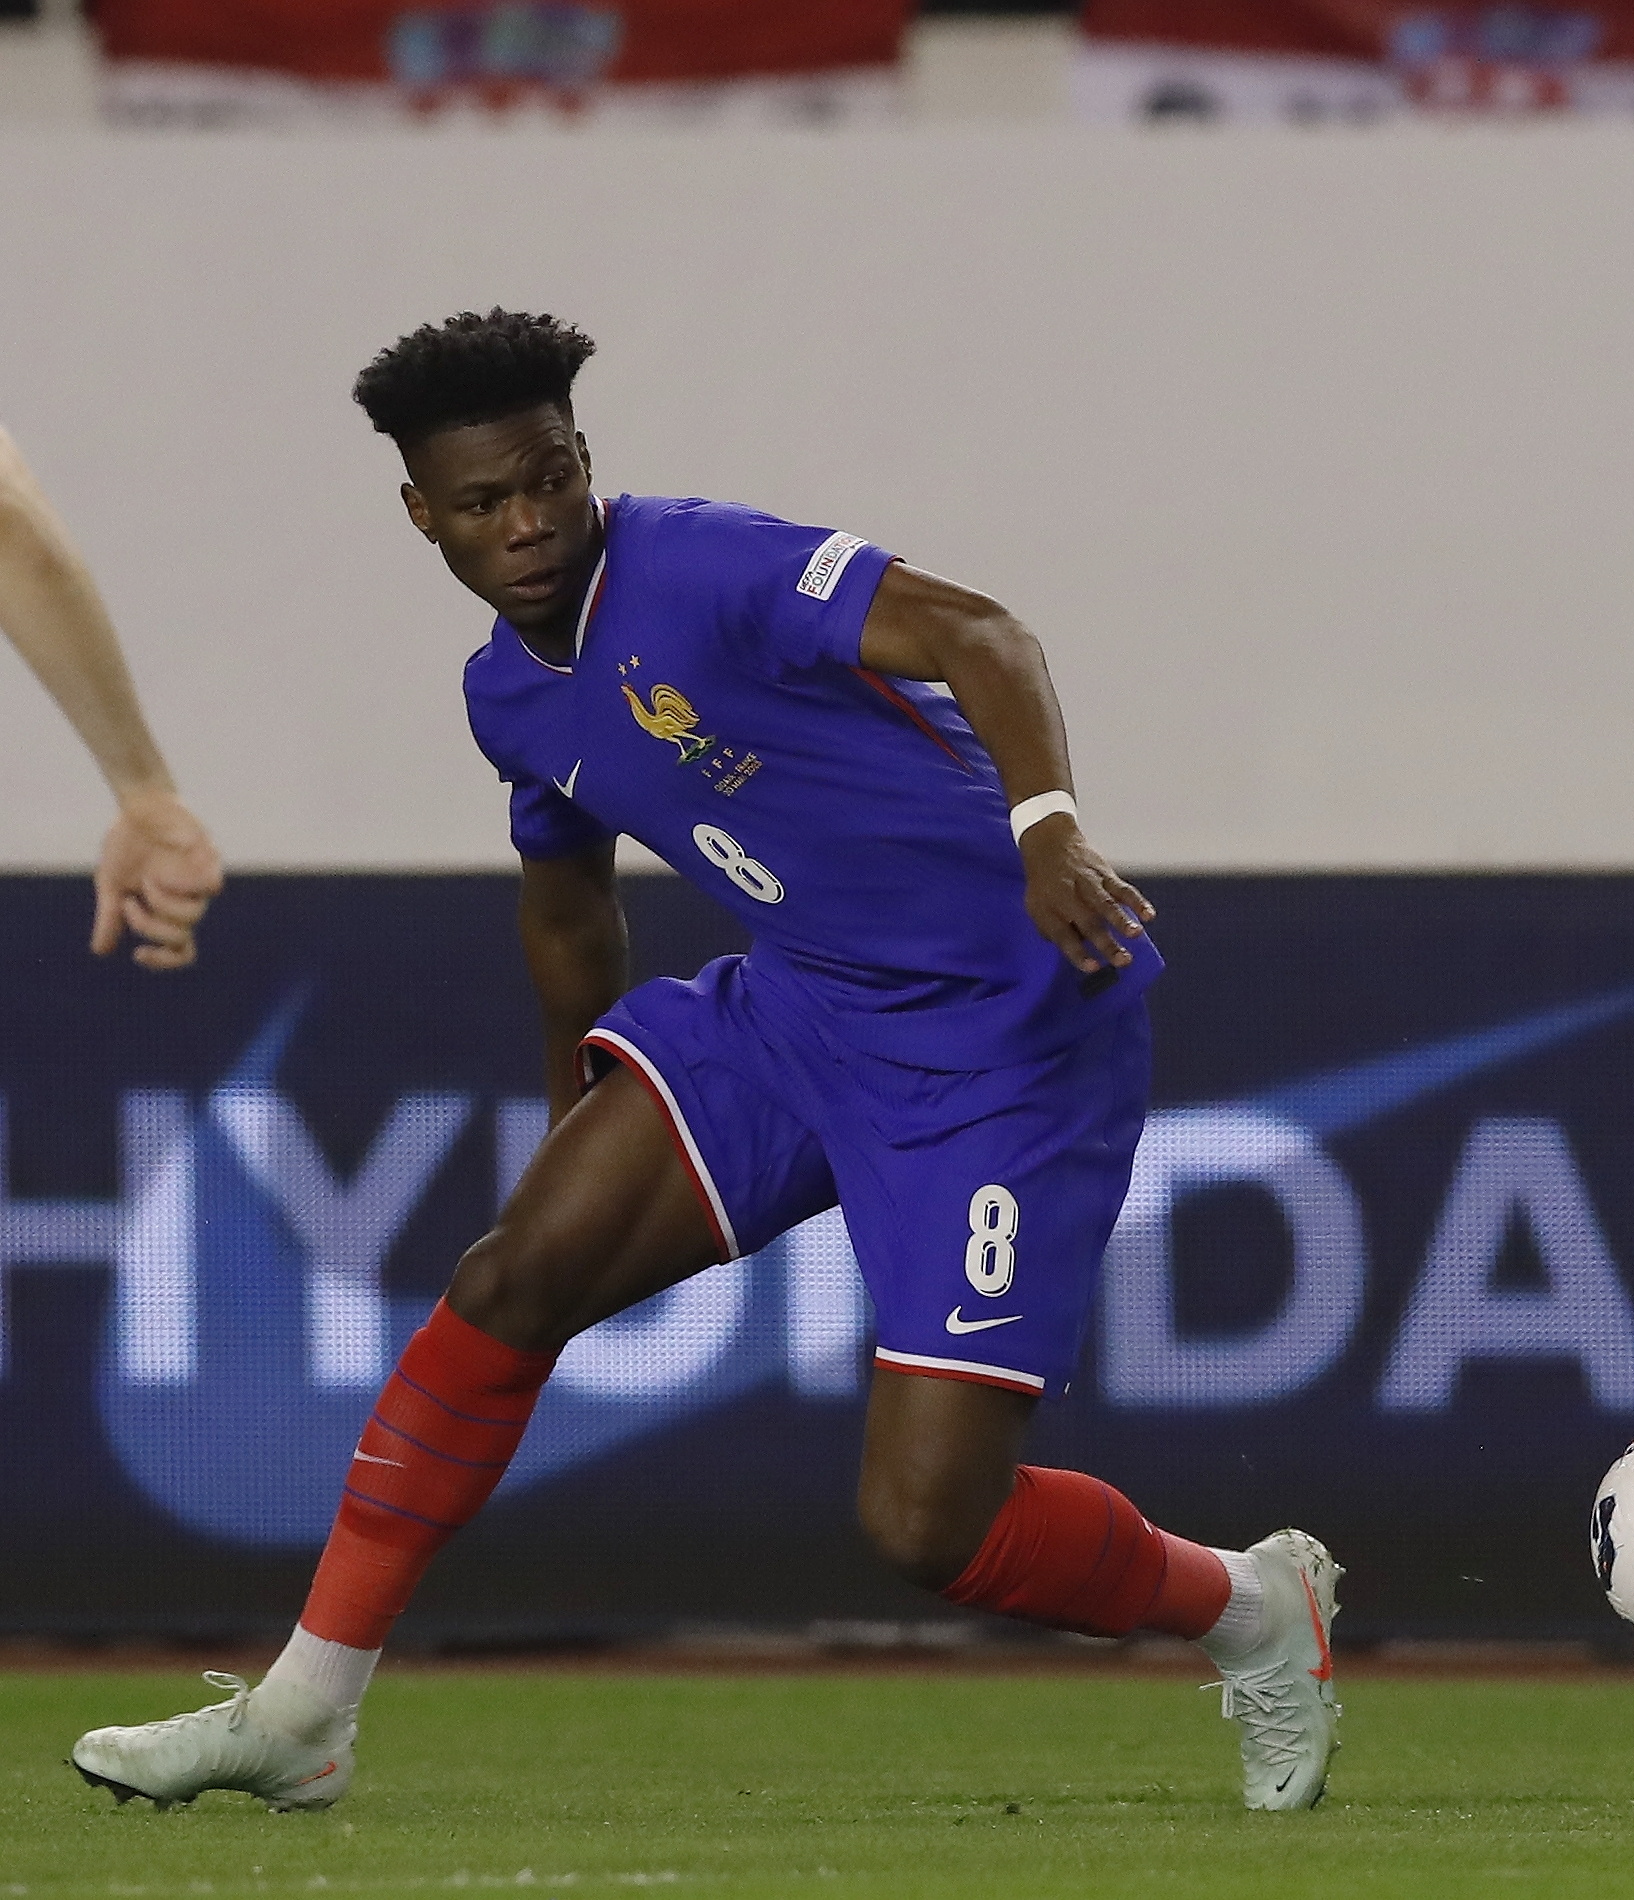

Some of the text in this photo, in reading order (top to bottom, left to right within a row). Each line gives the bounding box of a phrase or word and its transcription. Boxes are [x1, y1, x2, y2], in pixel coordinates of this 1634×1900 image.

[807, 536, 855, 594] FOUNDAT
[693, 823, 785, 904] 8
[965, 1183, 1019, 1298] 8
